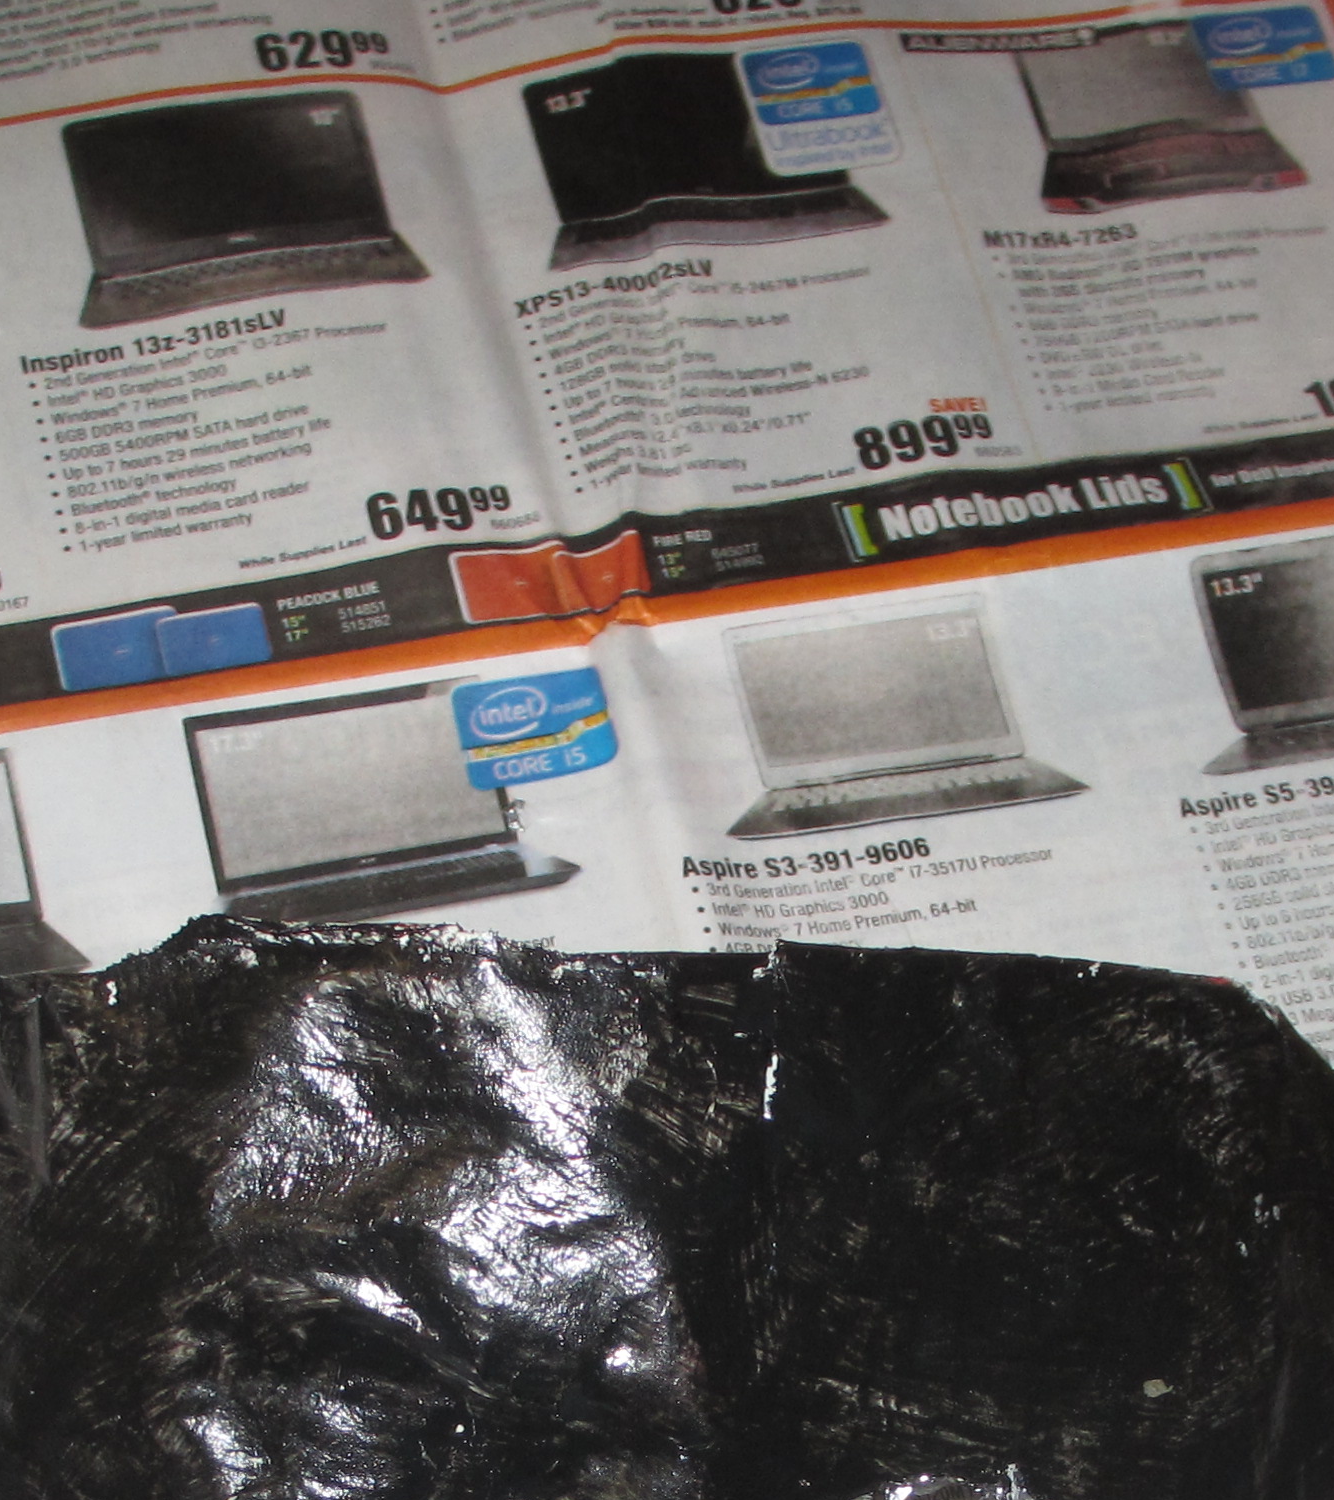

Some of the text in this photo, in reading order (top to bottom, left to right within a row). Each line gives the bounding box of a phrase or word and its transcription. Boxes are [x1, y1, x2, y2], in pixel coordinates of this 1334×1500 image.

[20, 309, 284, 374] Inspiron 13z-3181sLV
[928, 396, 988, 415] SAVE!
[879, 471, 1169, 543] Notebook Lids
[478, 693, 535, 729] intel
[494, 751, 553, 783] CORE
[1181, 792, 1257, 817] Aspire
[682, 837, 931, 884] Aspire S3-391-9606
